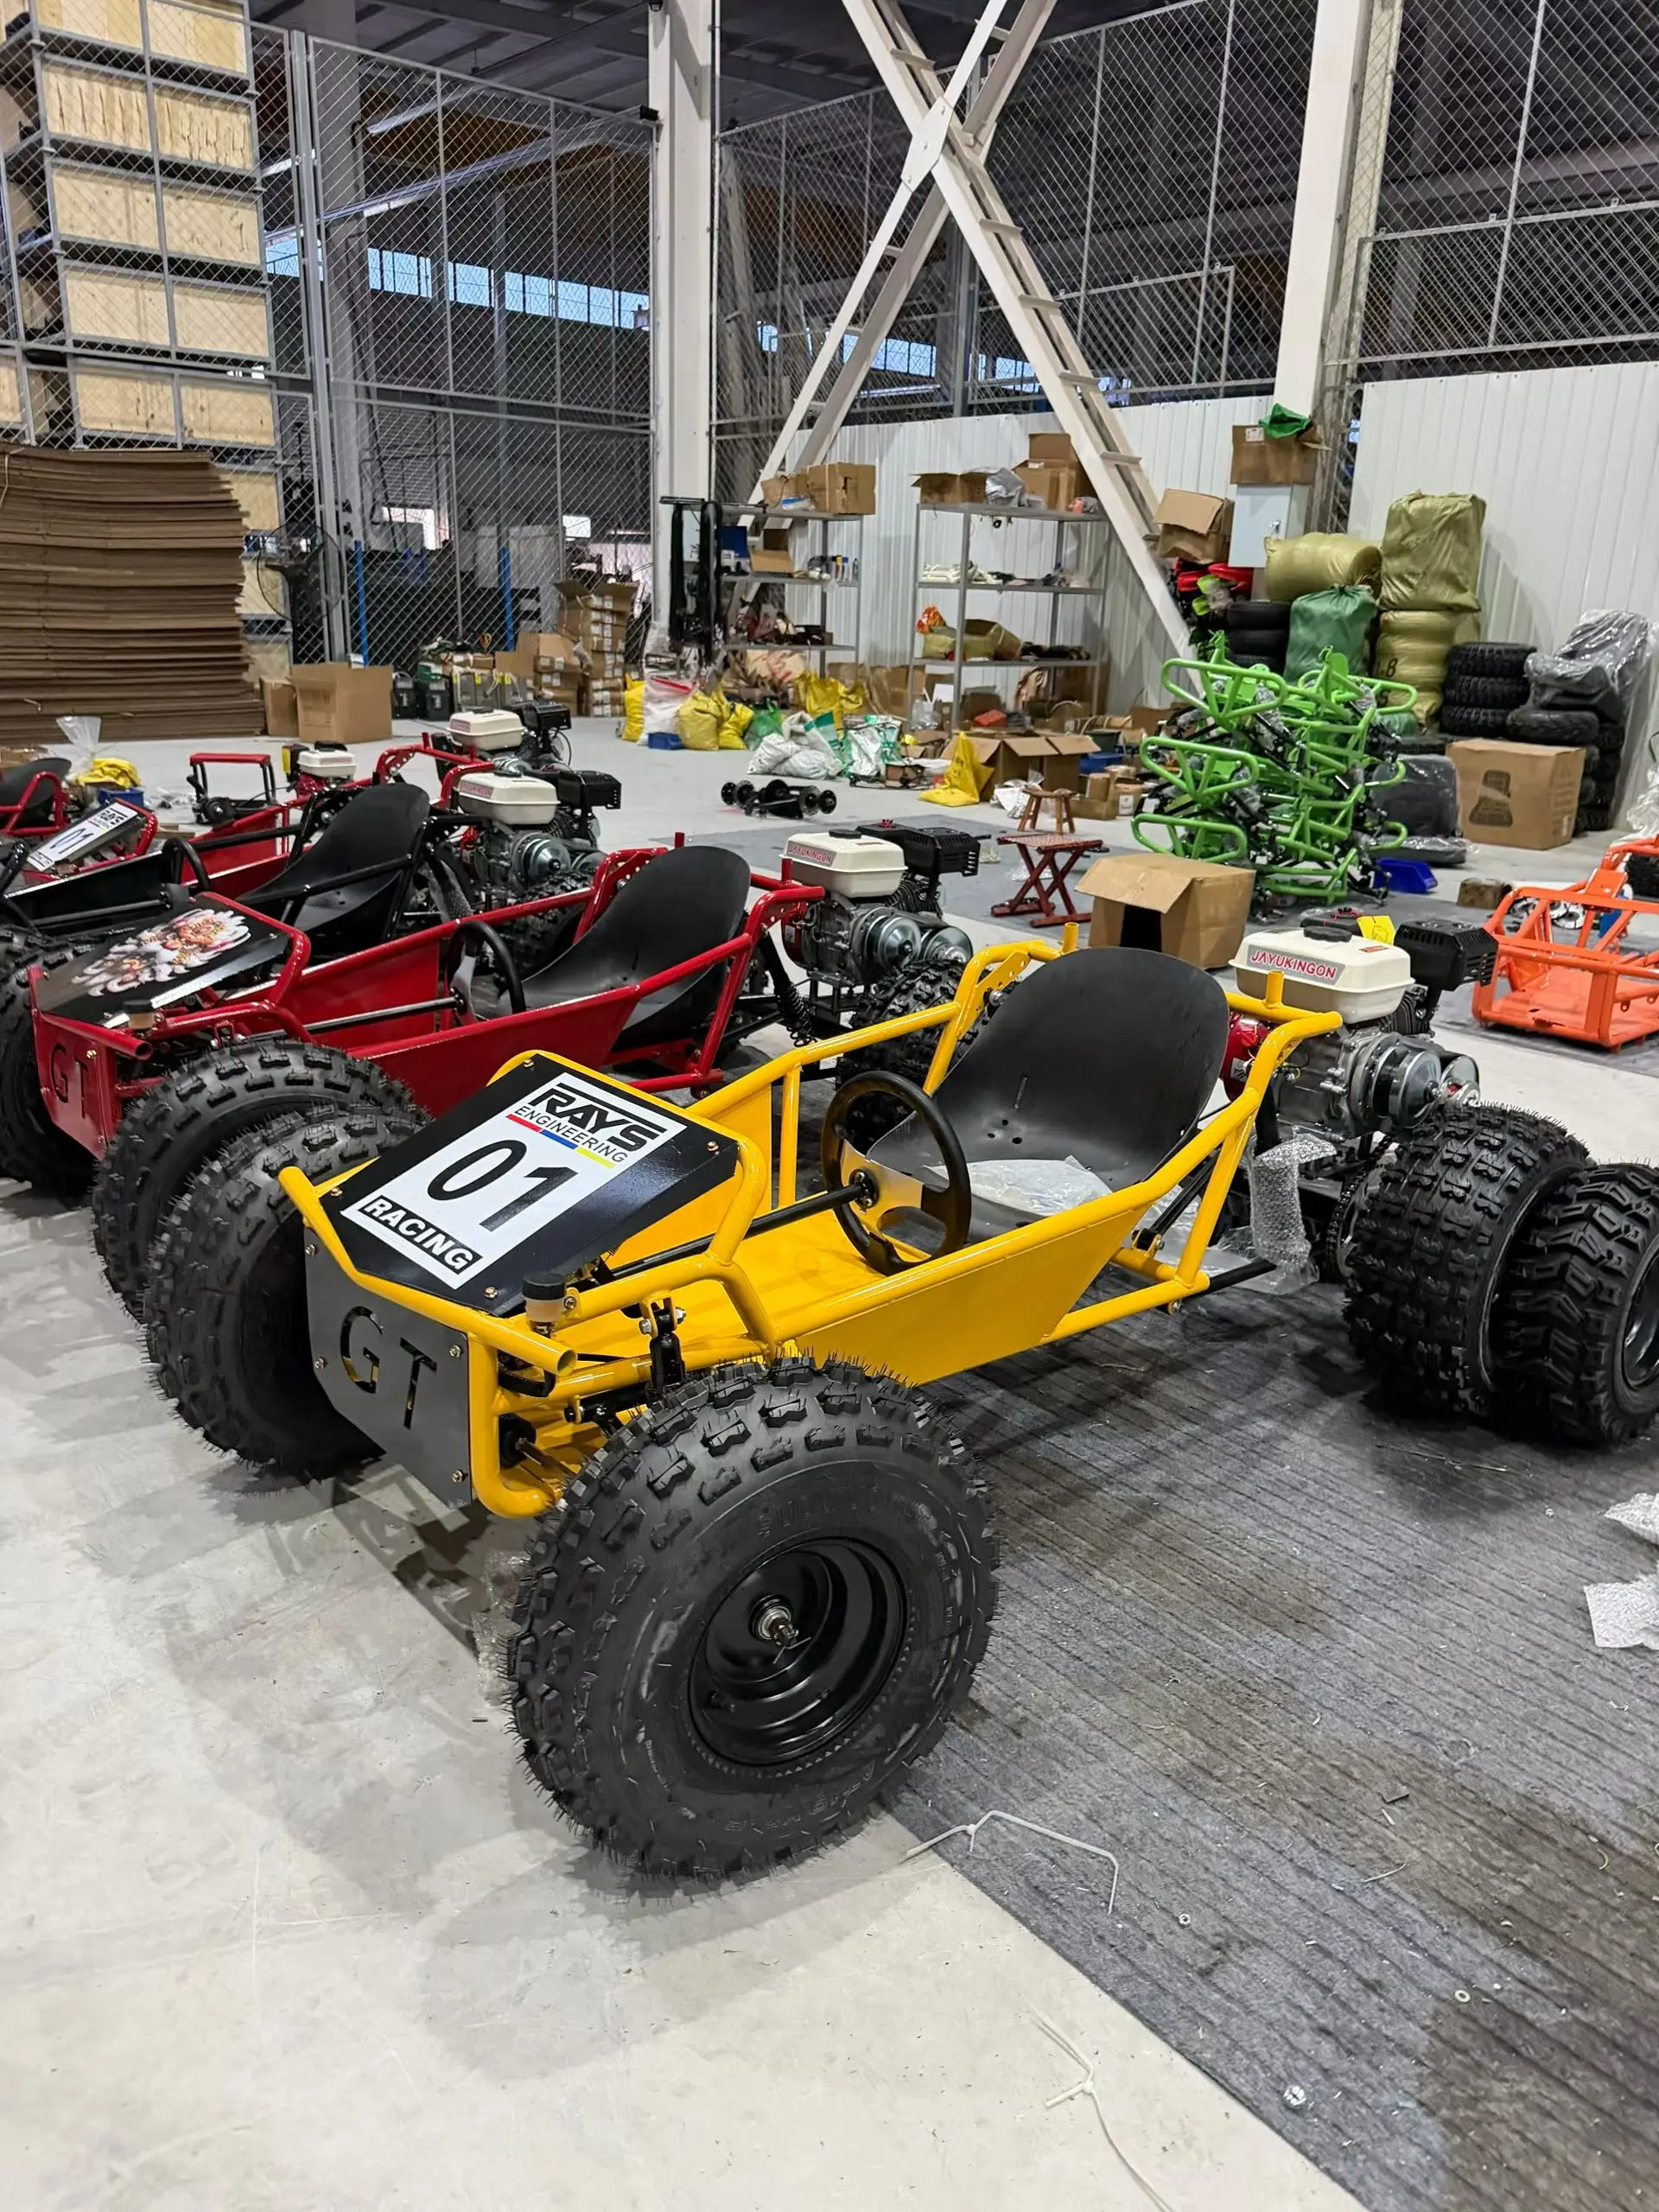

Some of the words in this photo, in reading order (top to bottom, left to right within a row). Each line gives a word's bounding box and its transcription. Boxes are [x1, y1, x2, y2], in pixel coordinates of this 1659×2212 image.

[1250, 950, 1337, 980] JAYUKINGON
[50, 1042, 89, 1119] GT
[513, 1105, 628, 1163] ENGINEERING
[528, 1086, 664, 1153] RAYS
[427, 1139, 579, 1232] 01
[363, 1196, 474, 1270] RACING
[340, 1305, 438, 1431] GT
